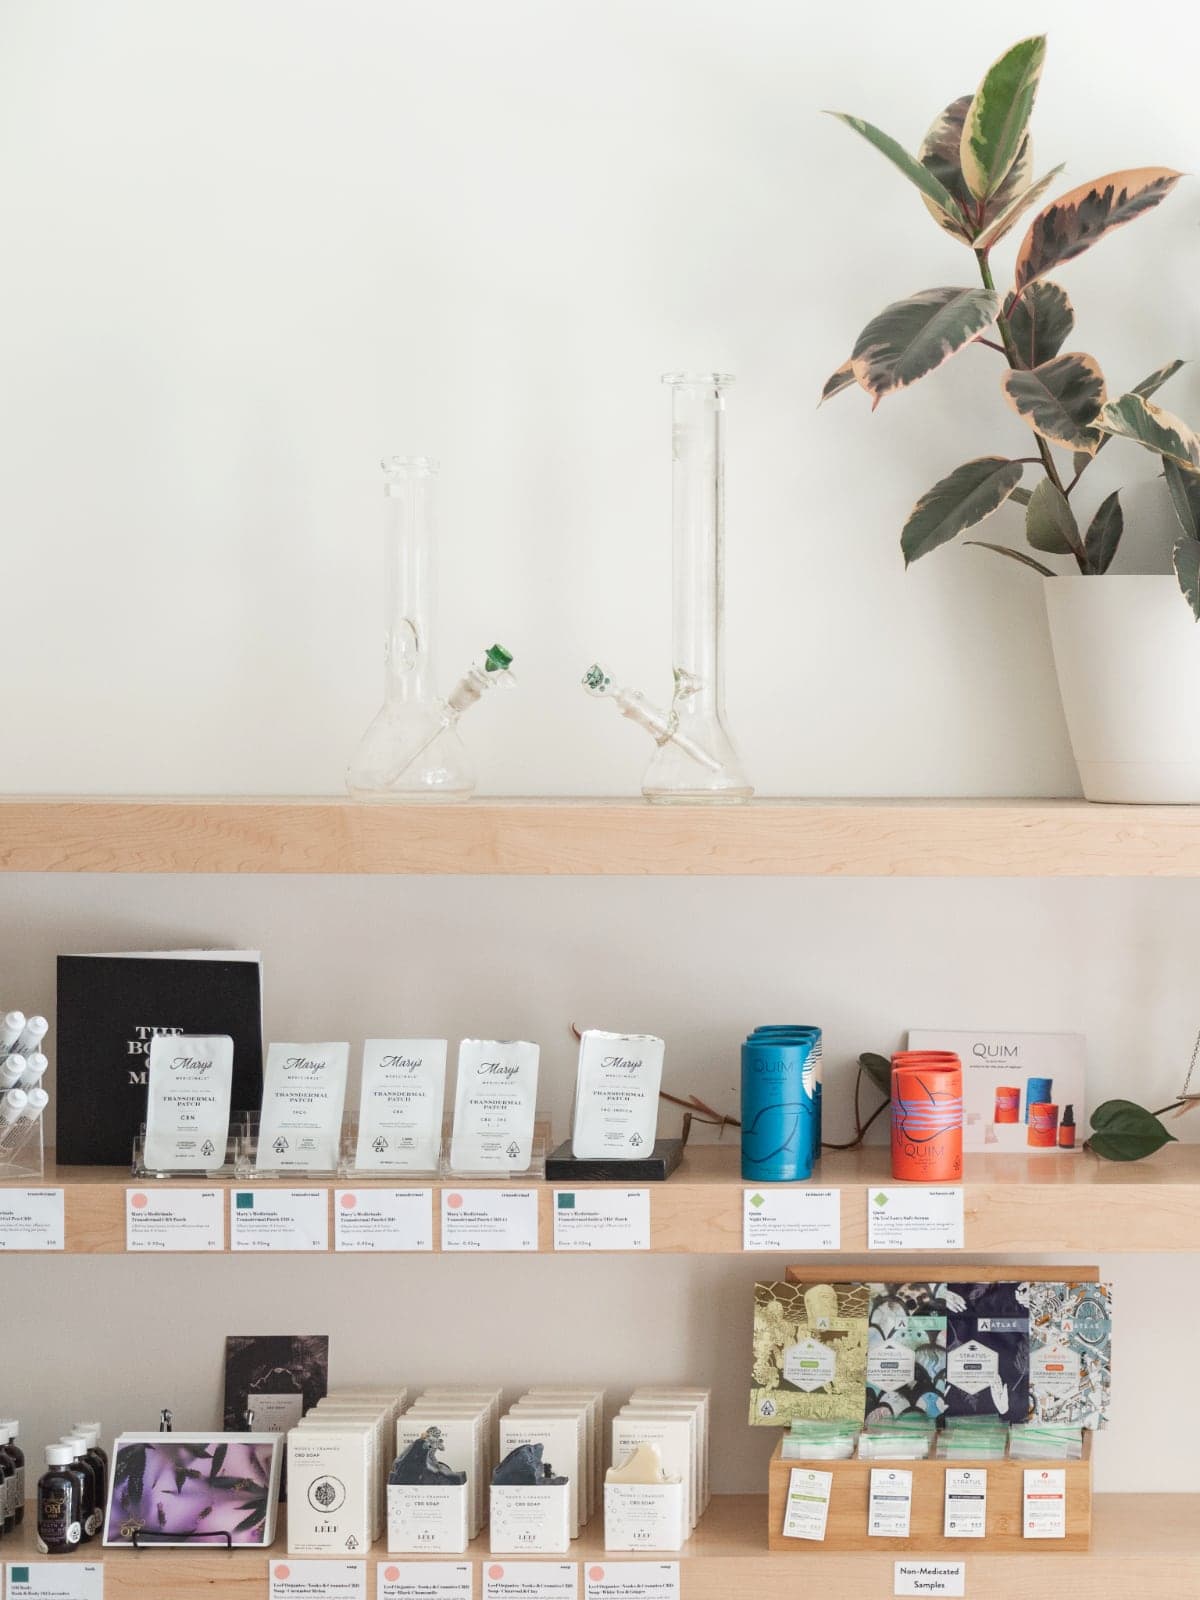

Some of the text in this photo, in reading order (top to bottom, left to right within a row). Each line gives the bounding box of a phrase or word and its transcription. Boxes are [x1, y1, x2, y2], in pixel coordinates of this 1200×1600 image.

[972, 1043, 1019, 1059] QUIM
[752, 1059, 794, 1074] QUIM
[905, 1144, 945, 1158] QUIM
[914, 1581, 945, 1590] Samples
